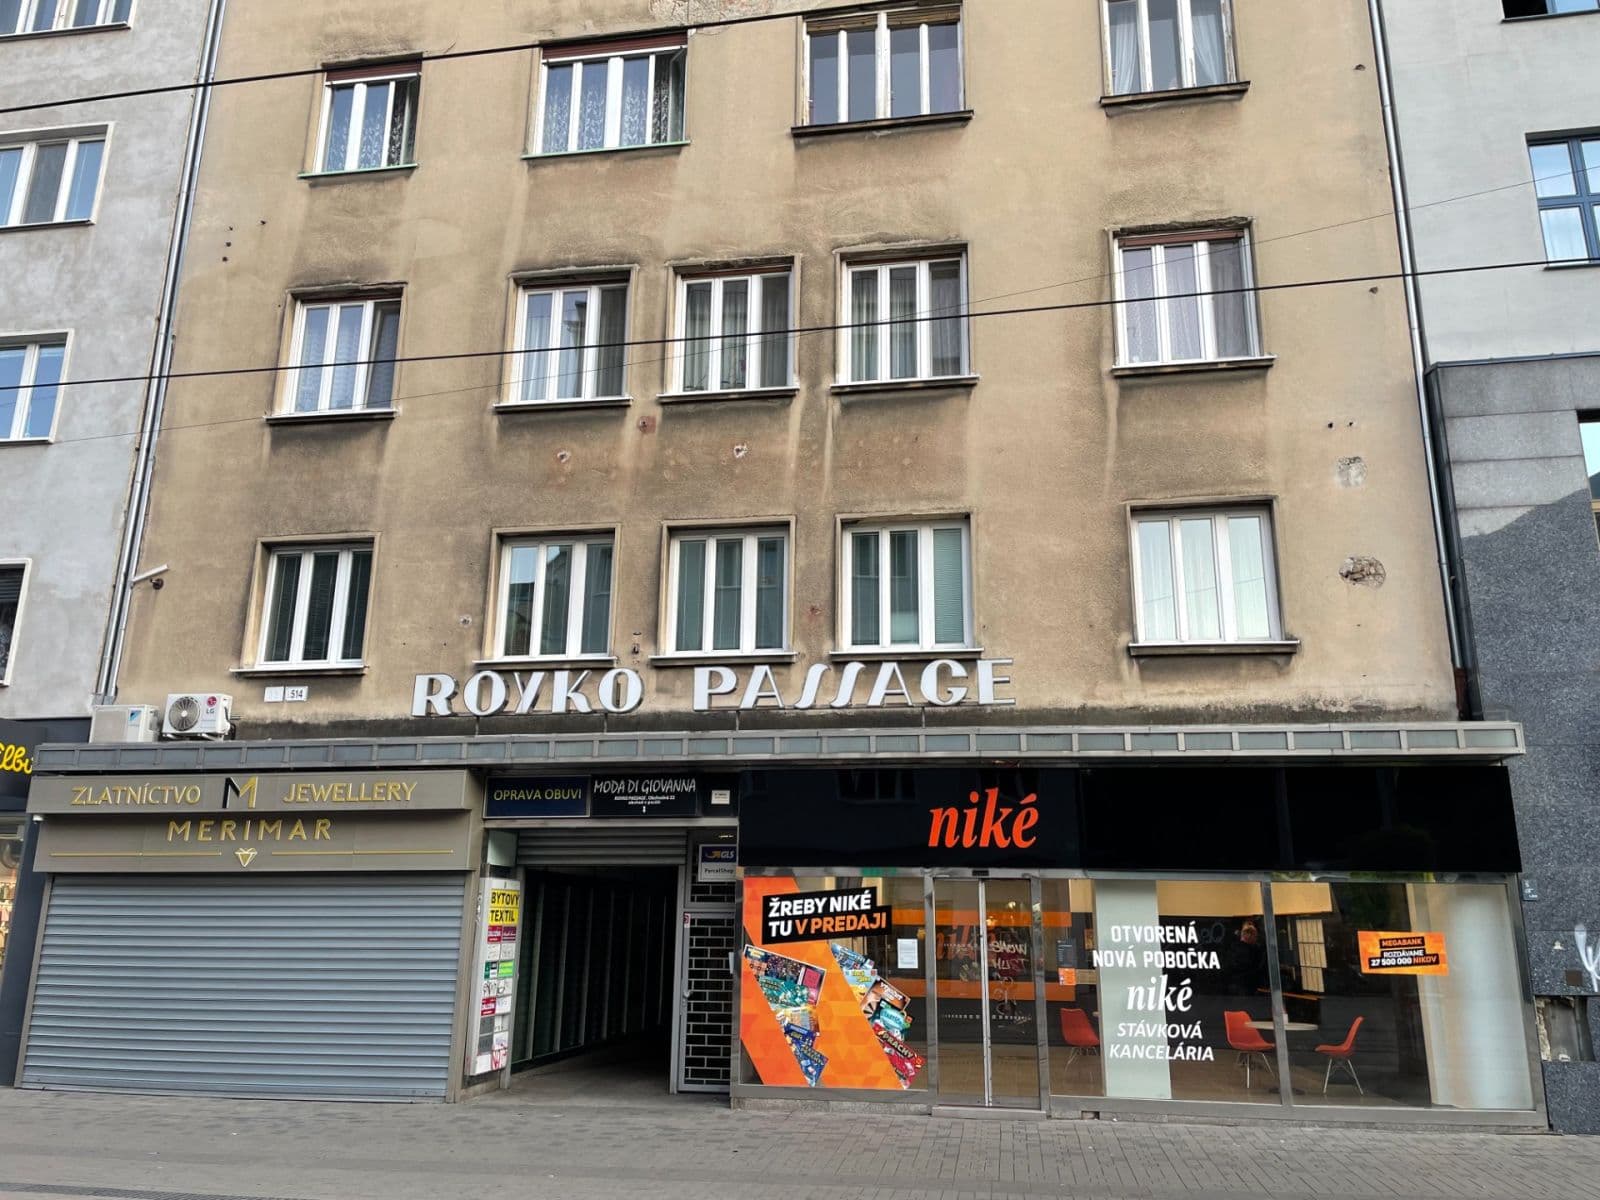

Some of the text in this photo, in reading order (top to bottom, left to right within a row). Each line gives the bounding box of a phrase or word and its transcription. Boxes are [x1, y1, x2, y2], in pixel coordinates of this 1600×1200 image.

[411, 658, 1016, 717] ROYKO PASSAGE
[71, 782, 201, 806] ZLATNÍCTVO
[283, 781, 417, 803] JEWELLERY
[493, 788, 582, 801] OPRAVA OBUVI
[593, 778, 696, 794] MODA DI GIOVANNA
[928, 787, 1039, 848] niké
[167, 819, 332, 841] MERIMAR
[721, 850, 735, 859] GLS
[768, 890, 872, 918] ŽREBY NIKÉ
[490, 909, 515, 922] TEXTIL
[768, 912, 887, 937] TU V PREDAJI
[1111, 921, 1198, 943] OTVORENÁ
[1381, 938, 1423, 947] MEGABANK
[1093, 945, 1136, 967] NOVÁ
[1143, 948, 1220, 969] POBOČKA
[1396, 957, 1412, 965] 000
[1413, 956, 1437, 964] NIKOV
[1127, 974, 1193, 1012] niké
[1117, 1019, 1203, 1039] STÁVKOVÁ
[882, 1031, 913, 1058] PRACHY
[1109, 1041, 1214, 1061] KANCELÁRIA
